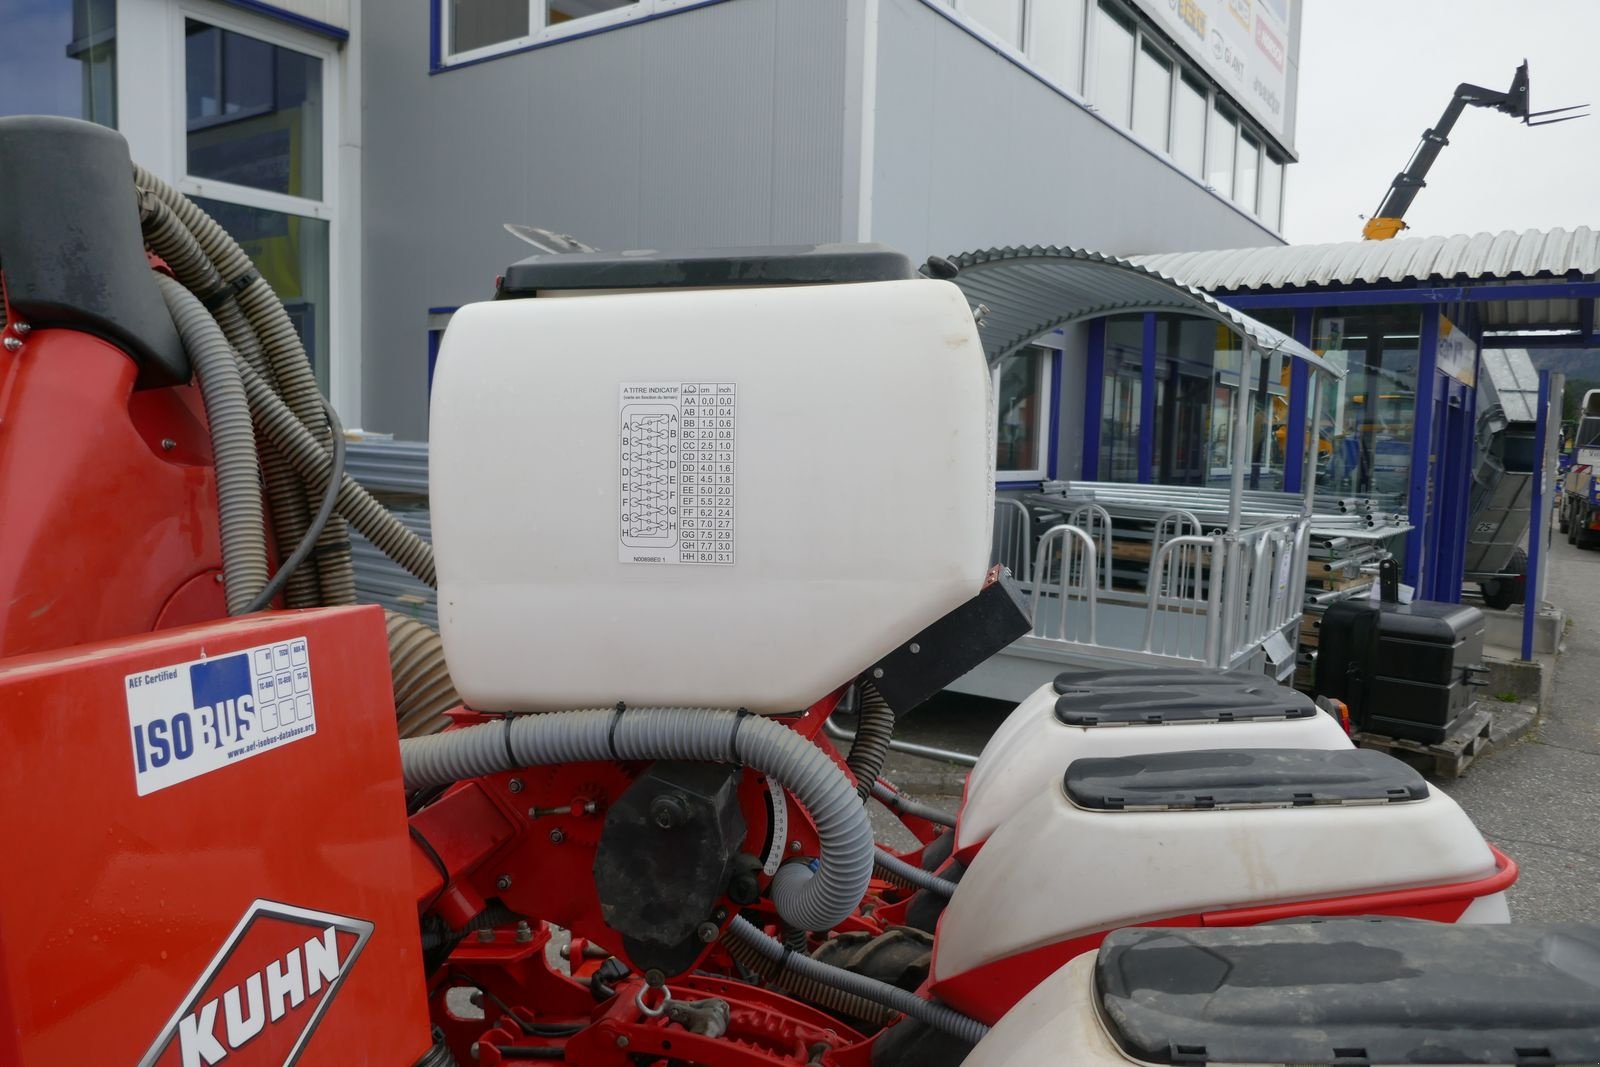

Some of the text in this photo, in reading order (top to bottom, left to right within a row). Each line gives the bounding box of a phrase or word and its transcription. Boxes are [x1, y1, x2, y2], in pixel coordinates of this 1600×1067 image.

[1478, 522, 1490, 532] 25
[129, 668, 178, 688] AEF Certified
[227, 722, 315, 759] www.aef-isobus-database.org
[178, 925, 340, 1067] KUHN
